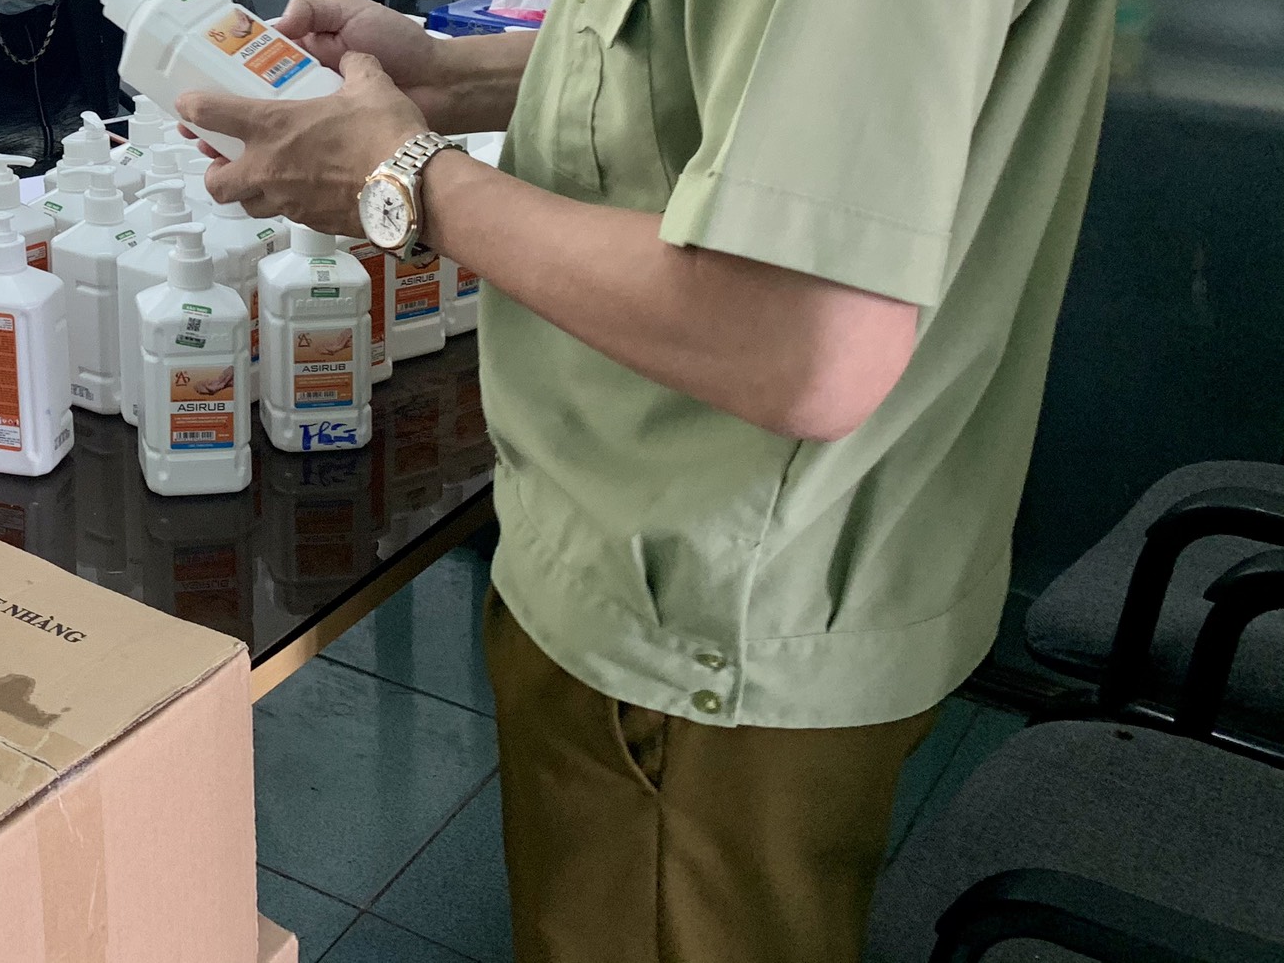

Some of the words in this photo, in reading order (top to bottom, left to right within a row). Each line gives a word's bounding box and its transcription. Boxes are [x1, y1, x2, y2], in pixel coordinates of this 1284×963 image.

[240, 33, 273, 59] ASIRUB
[400, 273, 435, 286] ASIRUB
[302, 363, 346, 373] ASIRUB
[177, 402, 226, 412] ASIRUB
[1, 603, 87, 644] NHÀNG
